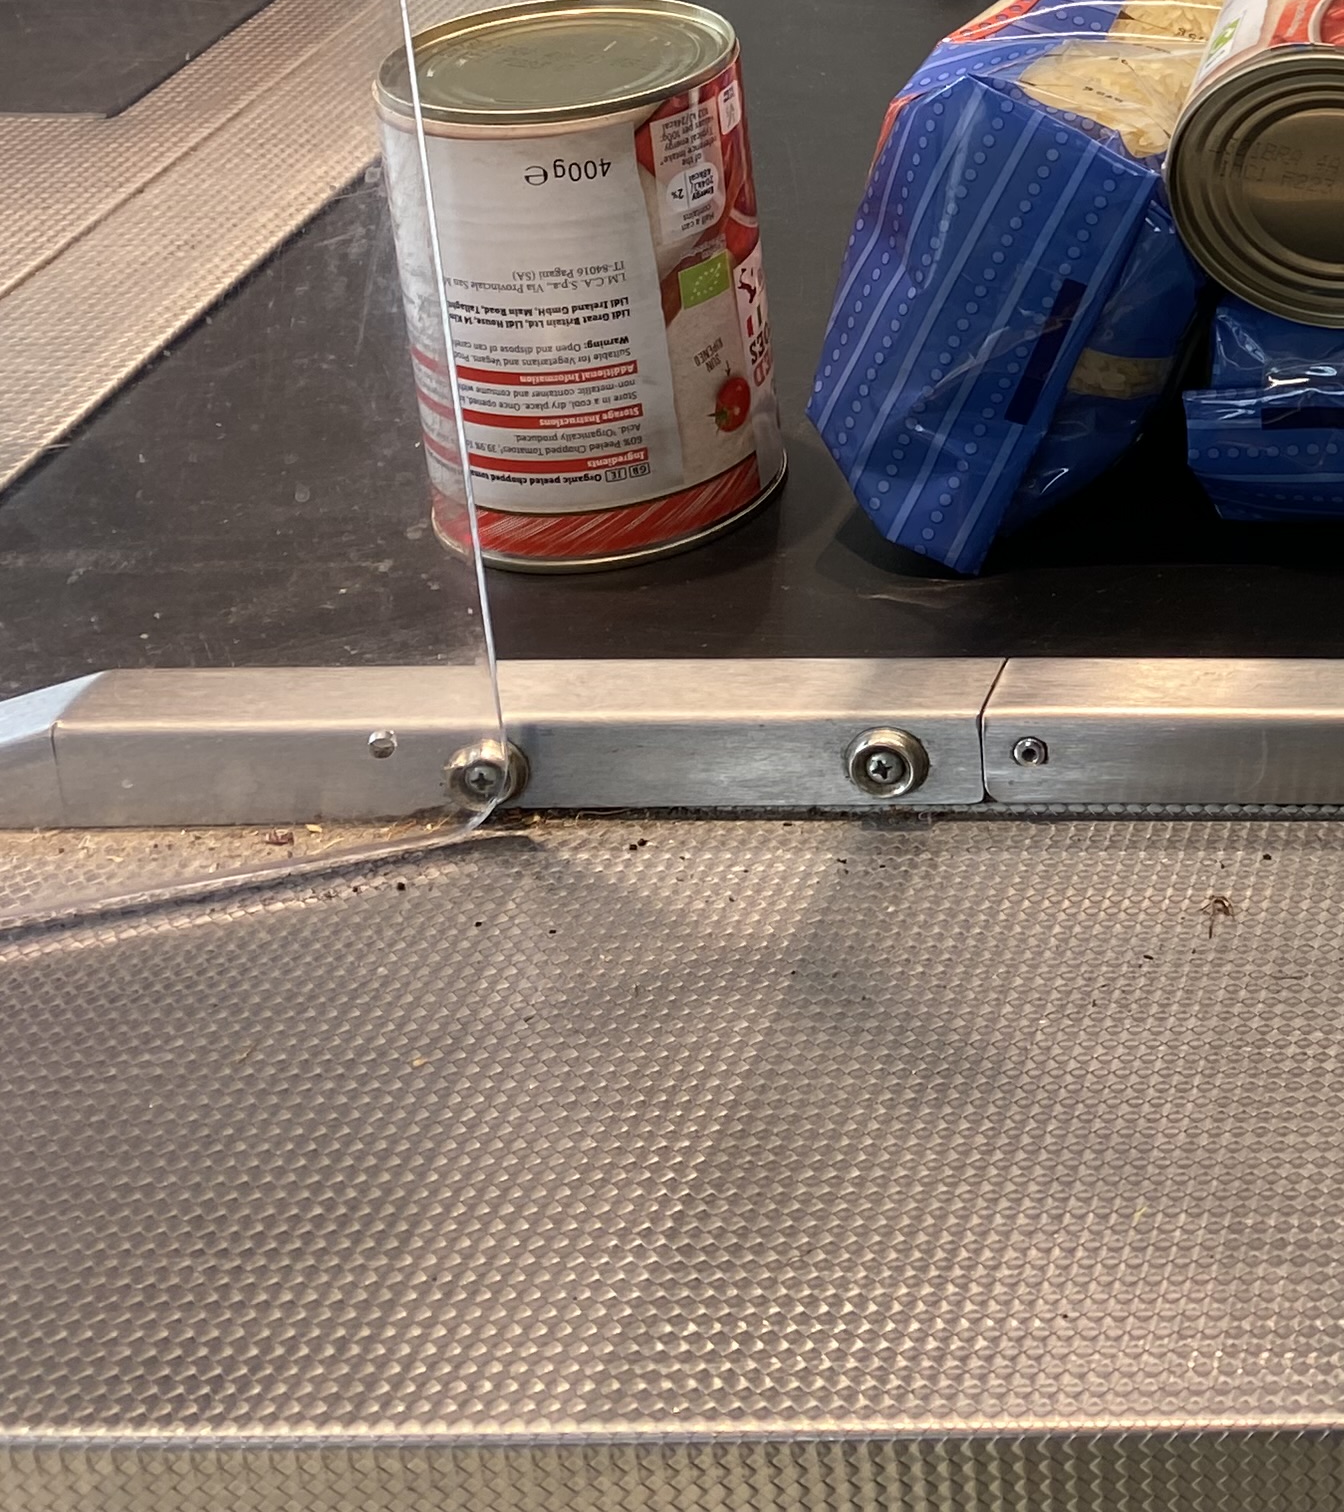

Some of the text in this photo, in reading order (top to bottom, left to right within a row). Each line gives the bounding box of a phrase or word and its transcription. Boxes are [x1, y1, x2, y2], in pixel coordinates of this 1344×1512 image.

[553, 158, 612, 182] 400g
[481, 297, 629, 316] Lidl Ireland GmbH, Main Road,
[501, 336, 629, 354] Warning: Open and dispose
[520, 365, 634, 384] Additional Information
[539, 407, 639, 427] Storage Instructions
[587, 450, 645, 467] Ingredients
